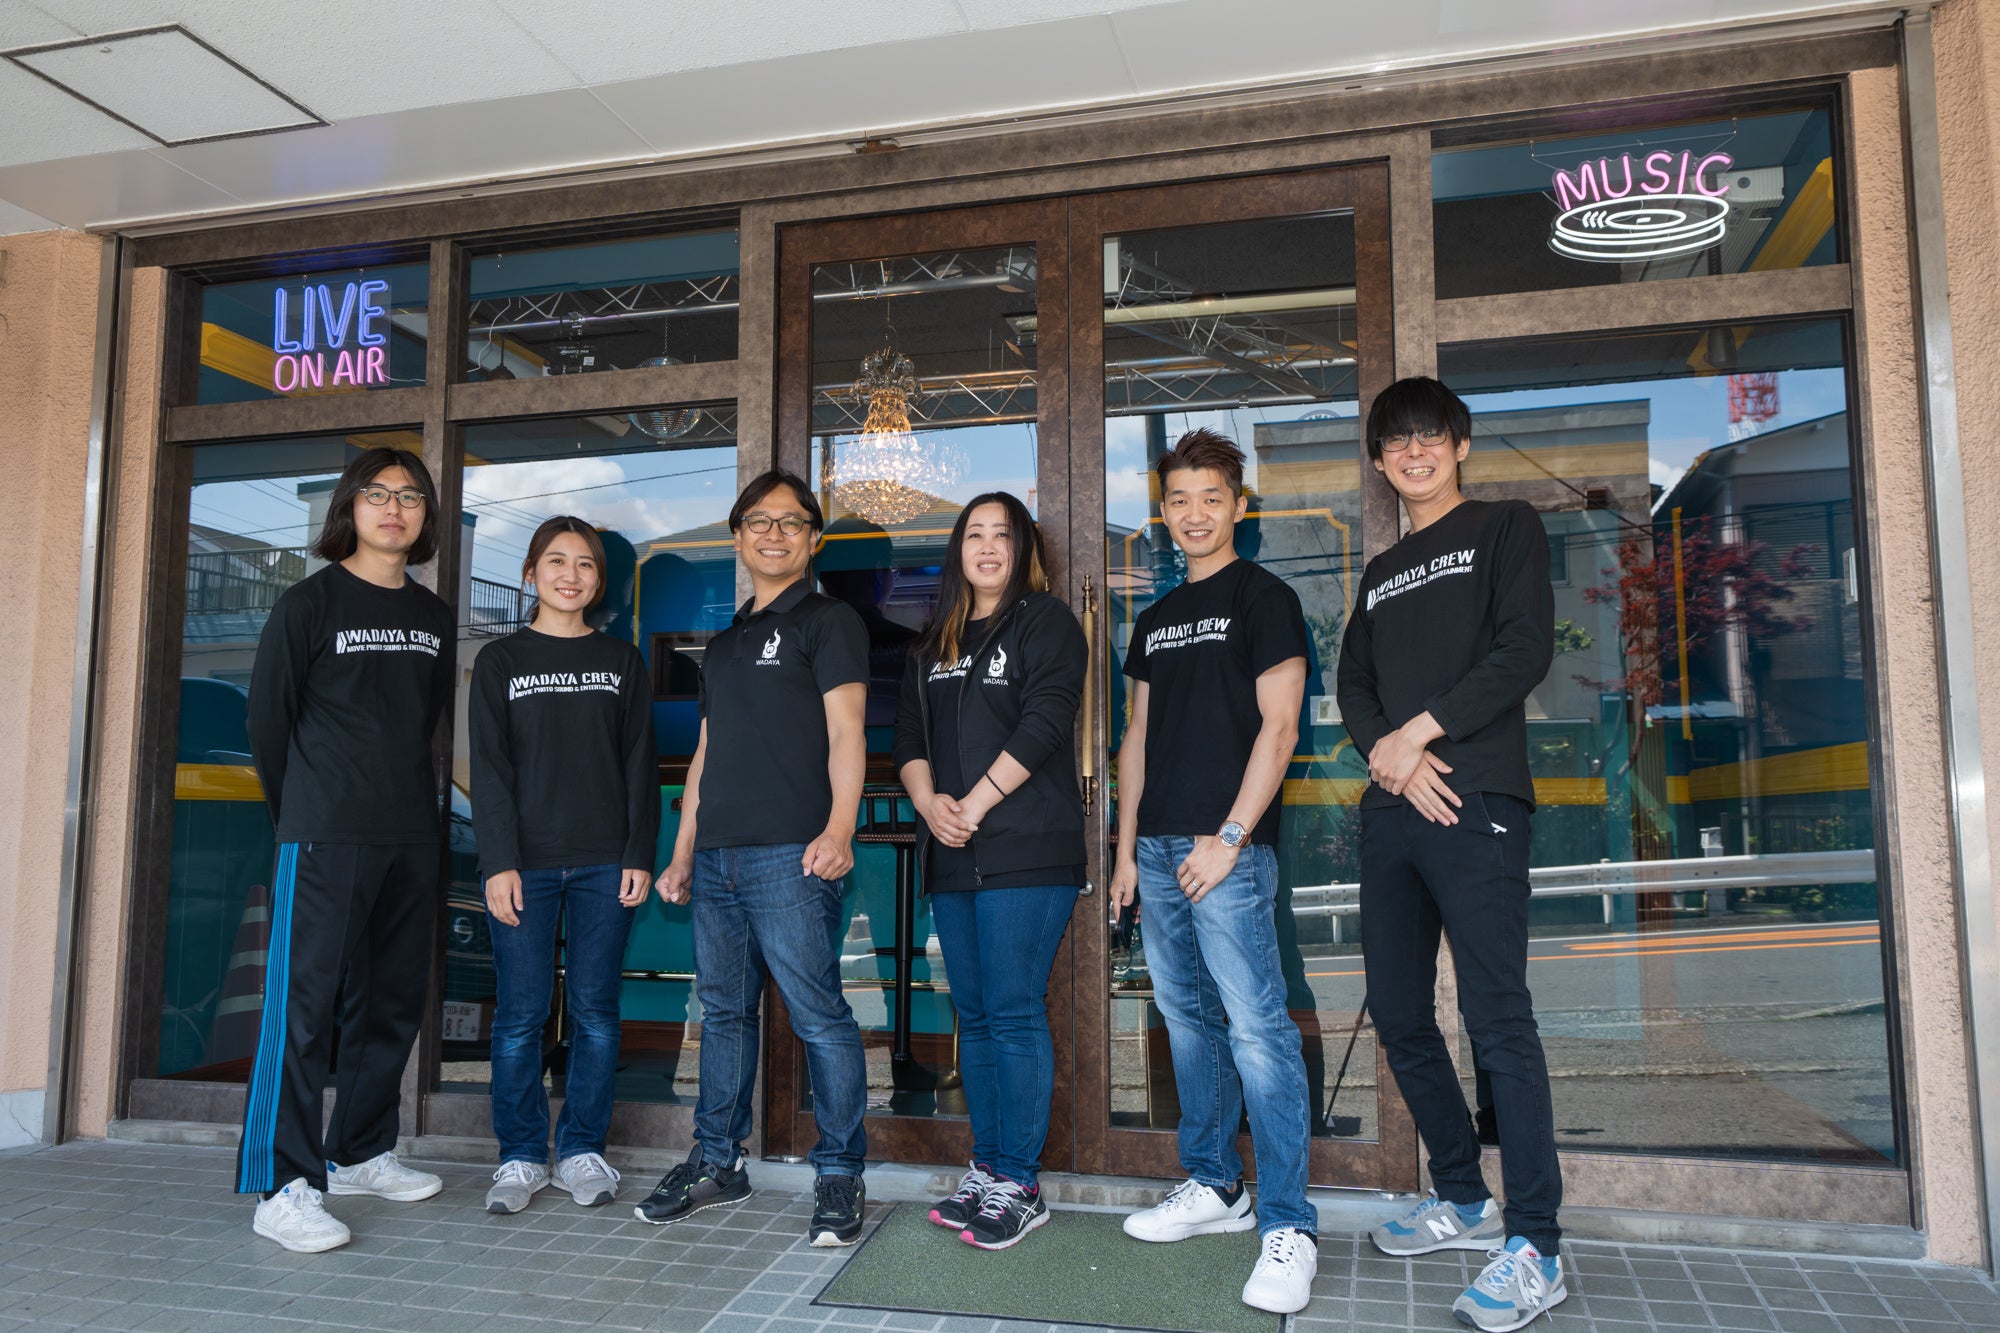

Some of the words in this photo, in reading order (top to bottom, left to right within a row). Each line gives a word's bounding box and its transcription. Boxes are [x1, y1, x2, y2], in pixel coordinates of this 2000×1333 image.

[1555, 152, 1732, 211] MUSIC
[274, 280, 388, 353] LIVE
[274, 353, 324, 391] ON
[332, 347, 385, 386] AIR
[1376, 564, 1427, 594] WADAYA
[1430, 549, 1476, 572] CREW
[1387, 587, 1404, 598] PHOTO
[1404, 579, 1422, 592] SOUND
[1427, 565, 1473, 583] ENTERTAINMENT
[1196, 617, 1231, 635] CREW
[345, 629, 406, 643] WADAYA
[410, 630, 441, 650] CREW
[512, 673, 578, 690] WADAYA
[582, 672, 621, 687] CREW
[515, 689, 533, 698] MOVIE
[534, 686, 553, 694] PHOTO
[982, 678, 1009, 686] WADAYA
[1425, 1215, 1459, 1241] N
